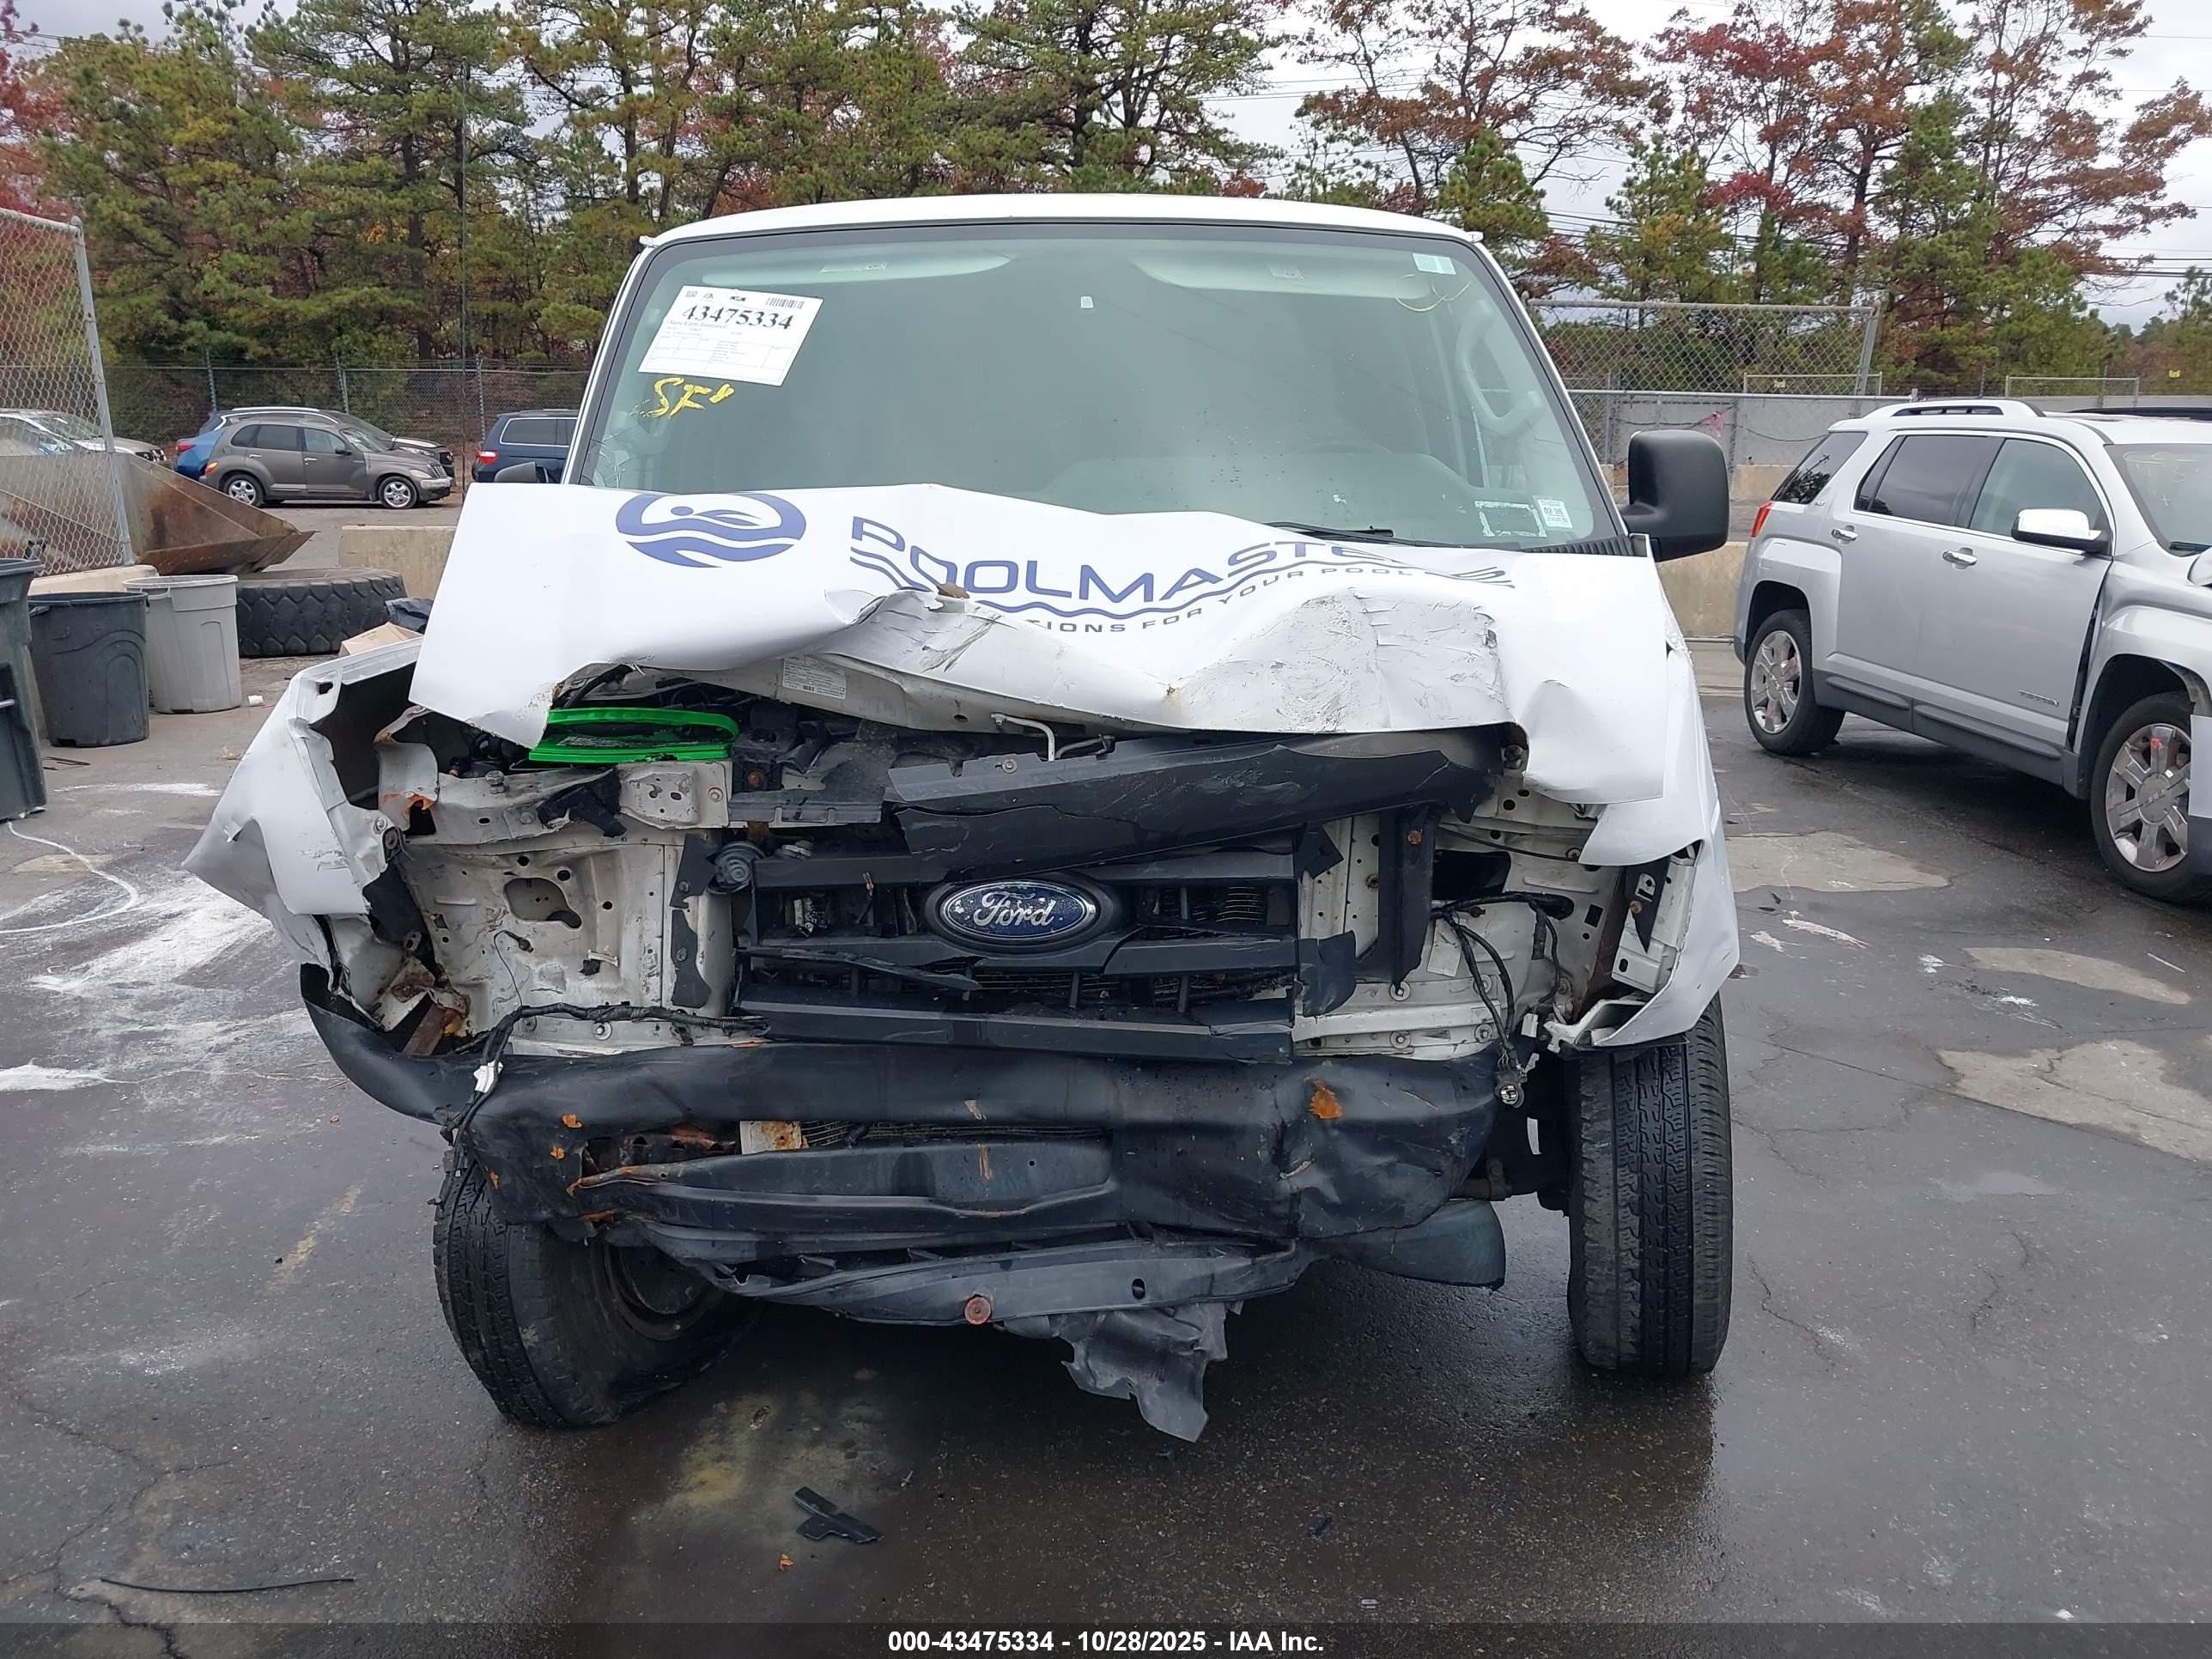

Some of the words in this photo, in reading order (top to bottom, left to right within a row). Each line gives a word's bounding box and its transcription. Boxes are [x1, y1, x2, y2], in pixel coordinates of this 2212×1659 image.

[682, 305, 795, 331] 43475334
[1141, 607, 1202, 630] FOR
[1217, 570, 1304, 605] YOUR
[1321, 567, 1413, 576] POOL
[973, 890, 1056, 927] Ford
